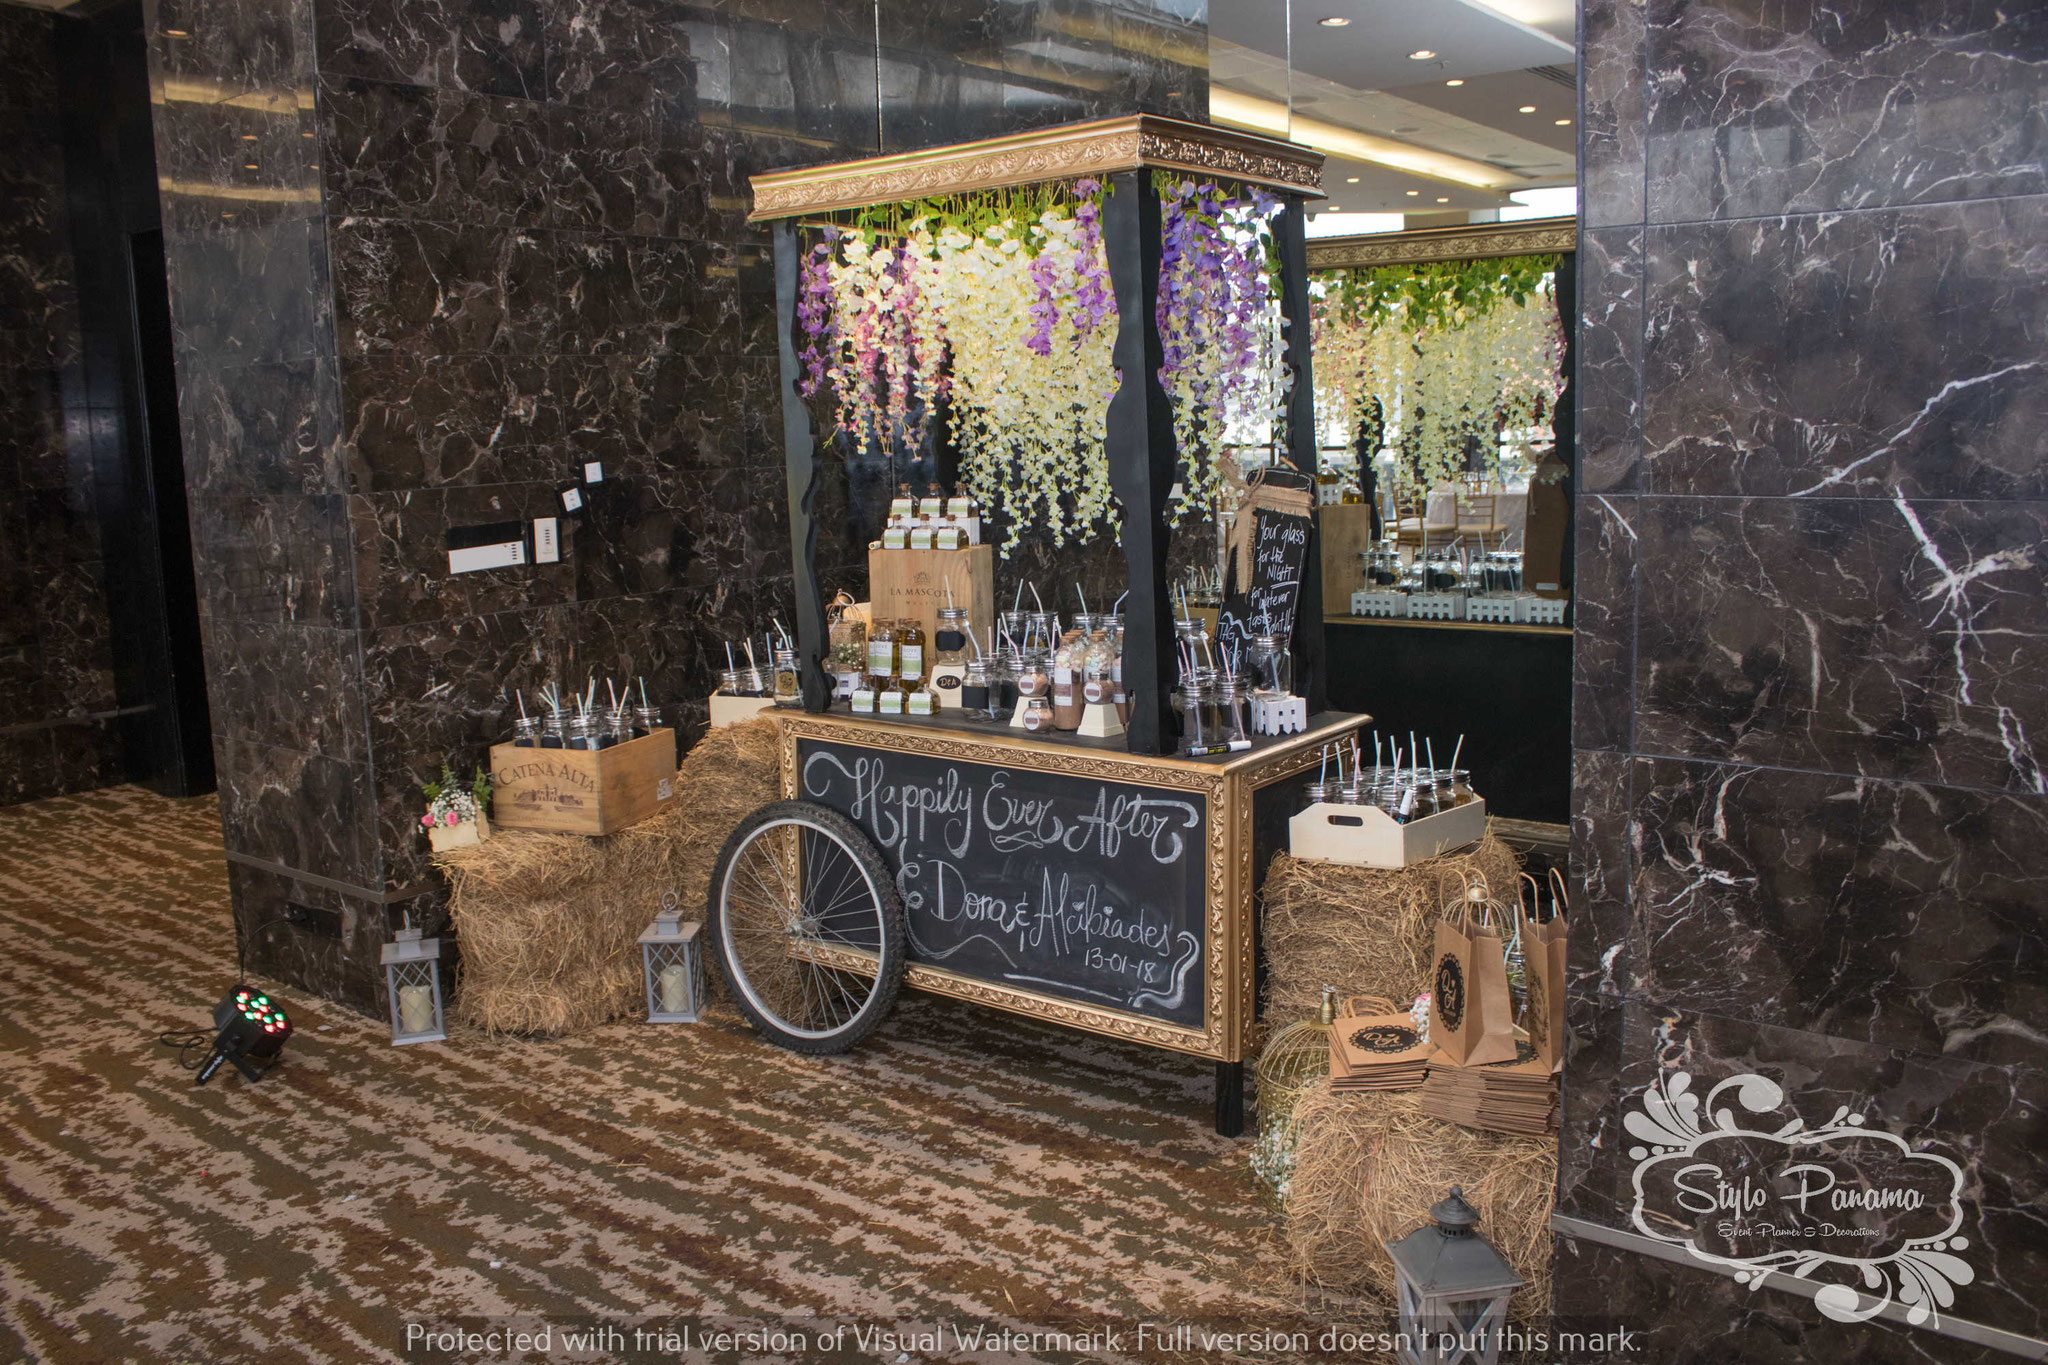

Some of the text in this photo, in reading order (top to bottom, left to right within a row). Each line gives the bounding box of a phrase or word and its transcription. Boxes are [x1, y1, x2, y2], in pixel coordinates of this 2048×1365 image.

[1257, 514, 1305, 554] Your glass
[1257, 545, 1284, 572] for the
[1266, 563, 1295, 582] NIGHT
[890, 588, 902, 596] LA
[1251, 586, 1263, 607] for
[1218, 621, 1236, 643] TAG
[499, 763, 595, 793] CATENA ALTA
[804, 751, 1199, 865] Happily Ever After
[1085, 947, 1156, 983] 13-01-18
